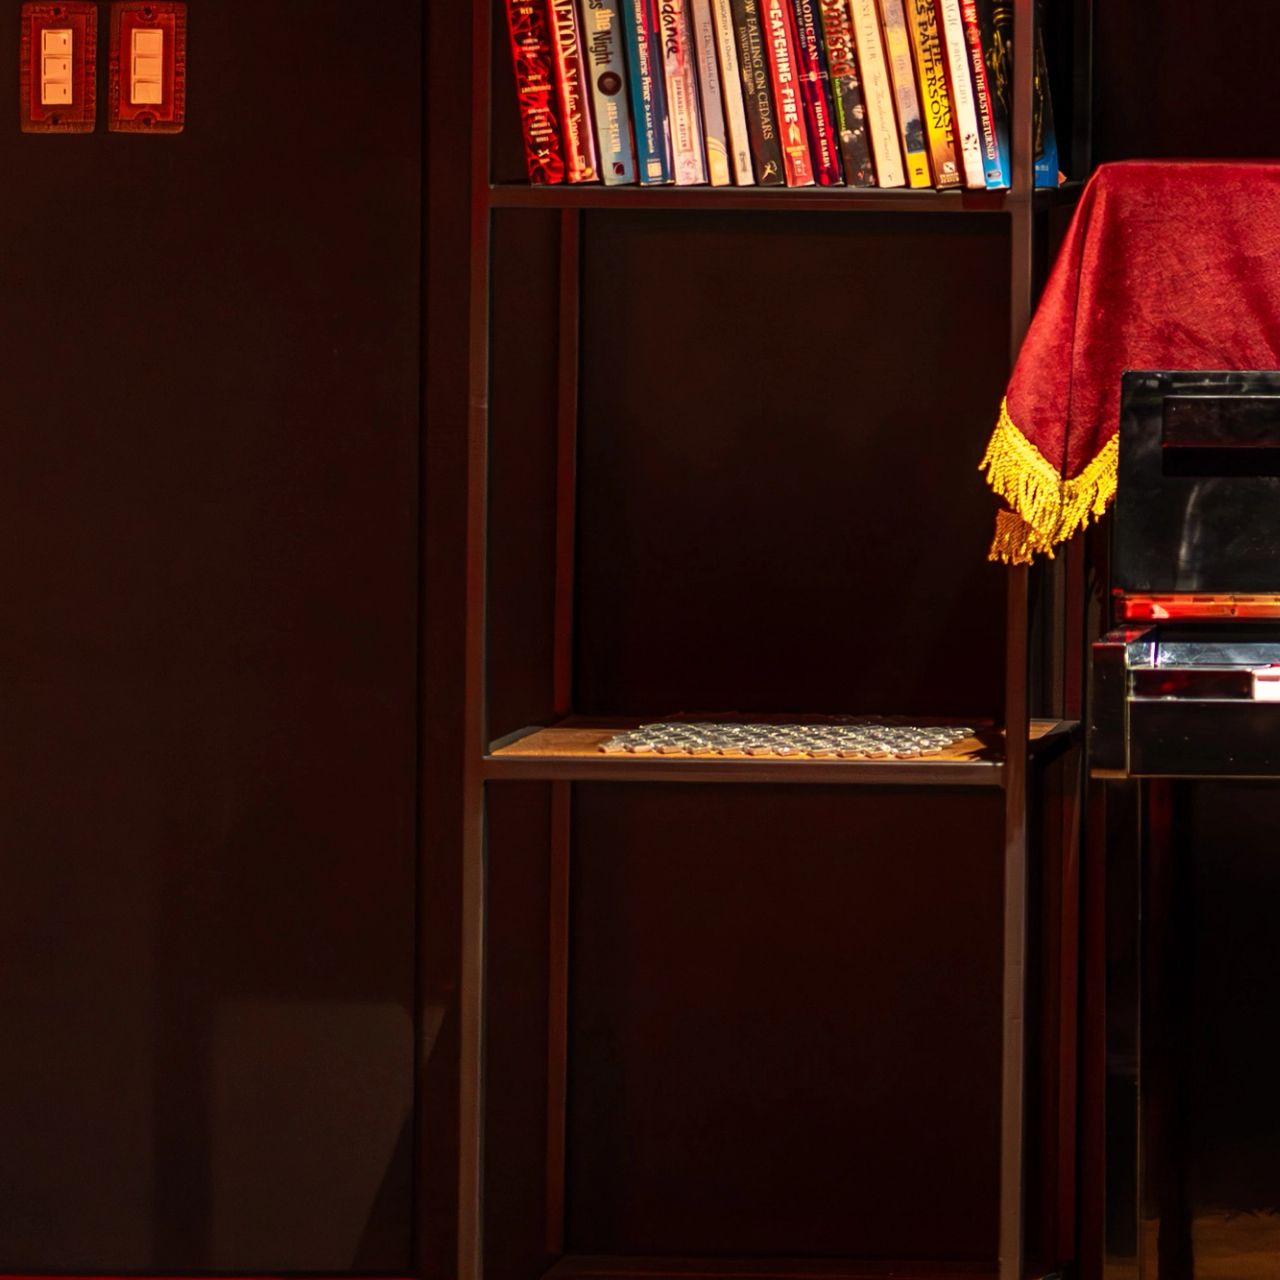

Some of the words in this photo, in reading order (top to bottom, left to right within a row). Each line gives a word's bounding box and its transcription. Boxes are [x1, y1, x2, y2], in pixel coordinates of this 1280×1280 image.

[594, 9, 615, 31] the
[637, 26, 647, 34] of
[590, 31, 611, 66] Night
[739, 27, 748, 55] DAVID
[747, 18, 762, 67] FALLING
[638, 43, 650, 75] Balinese
[771, 9, 791, 82] CATCHING
[781, 89, 797, 122] FIRE
[918, 21, 943, 130] PATTERSON
[642, 77, 651, 101] Prince
[753, 70, 765, 89] ON
[928, 26, 943, 65] THE
[936, 68, 953, 147] WEASEL
[757, 92, 773, 140] CEDARS
